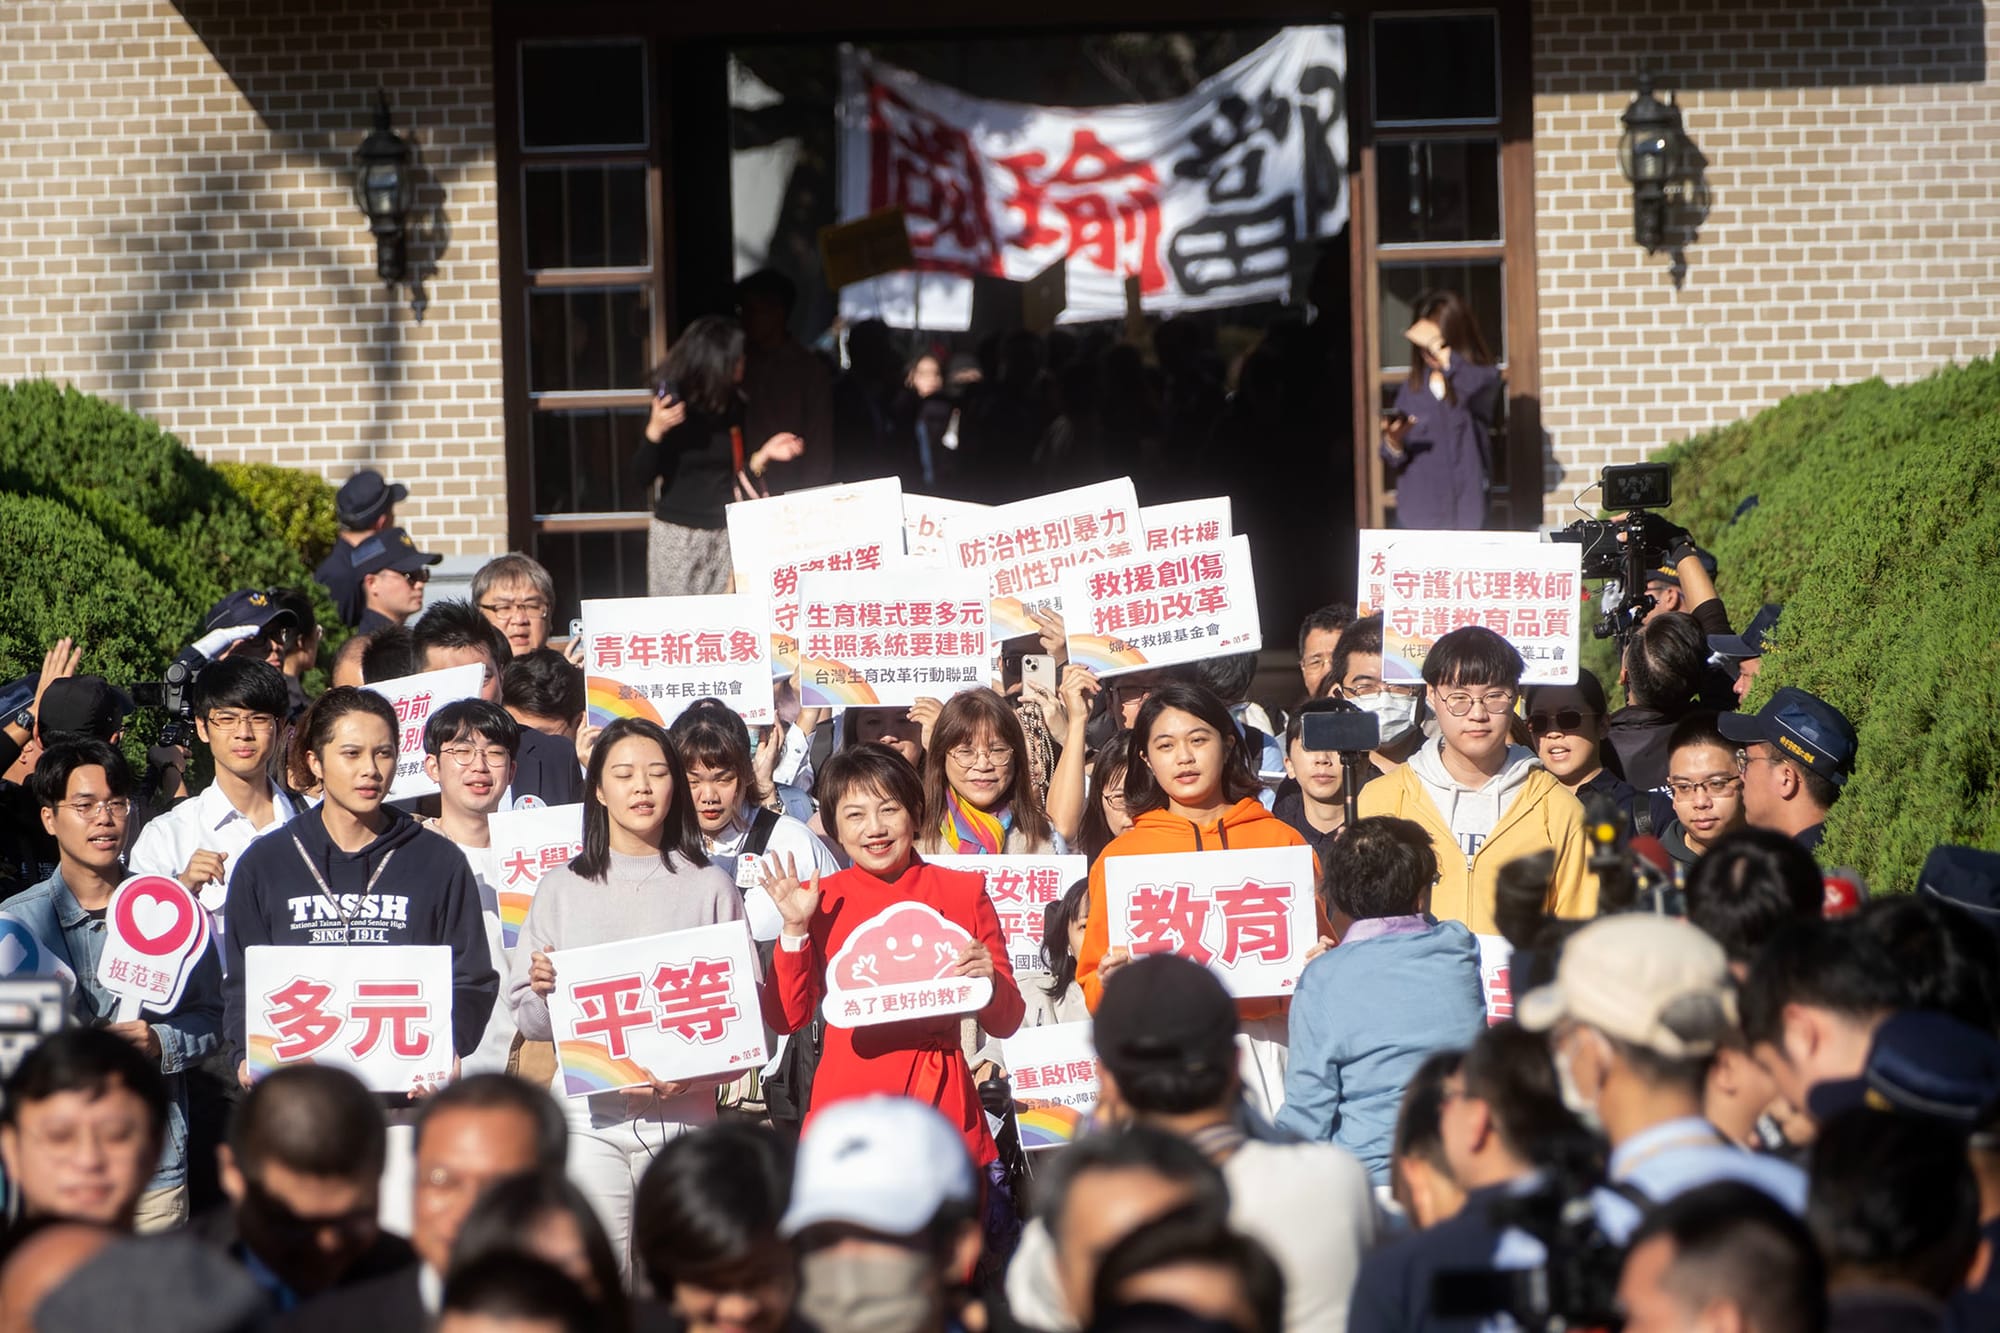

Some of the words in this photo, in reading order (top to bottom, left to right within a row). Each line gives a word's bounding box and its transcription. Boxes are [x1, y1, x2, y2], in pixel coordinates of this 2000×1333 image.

[959, 508, 1127, 568] 防治性別暴力
[1147, 520, 1219, 551] 居住權
[1090, 553, 1224, 600] 救援創傷
[1393, 570, 1573, 601] 守護代理教師
[808, 602, 984, 628] 生育模式要多元
[1094, 585, 1228, 634] 推動改革
[1392, 607, 1571, 637] 守護教育品質
[594, 630, 760, 668] 青年新氣象
[808, 631, 984, 659] 共照系統要建制
[1109, 622, 1220, 654] 婦女救援基金會
[1515, 645, 1567, 661] 業工會
[618, 680, 742, 701] 臺灣青年民主協會
[815, 666, 977, 685] 台灣生育改革行動聯盟
[399, 725, 426, 753] 別
[505, 844, 583, 885] 大學
[958, 869, 1060, 904] 女權
[288, 894, 409, 921] TNSSH
[290, 921, 318, 930] National
[367, 919, 389, 928] Senior
[390, 920, 407, 930] High
[354, 929, 385, 940] 1914
[1128, 881, 1294, 968] 教育
[107, 957, 171, 996] 挺范雲
[573, 959, 737, 1057] 平等
[843, 986, 972, 1018] 為了更好的教育
[268, 978, 429, 1060] 多元
[1013, 1060, 1097, 1091] 重啟障
